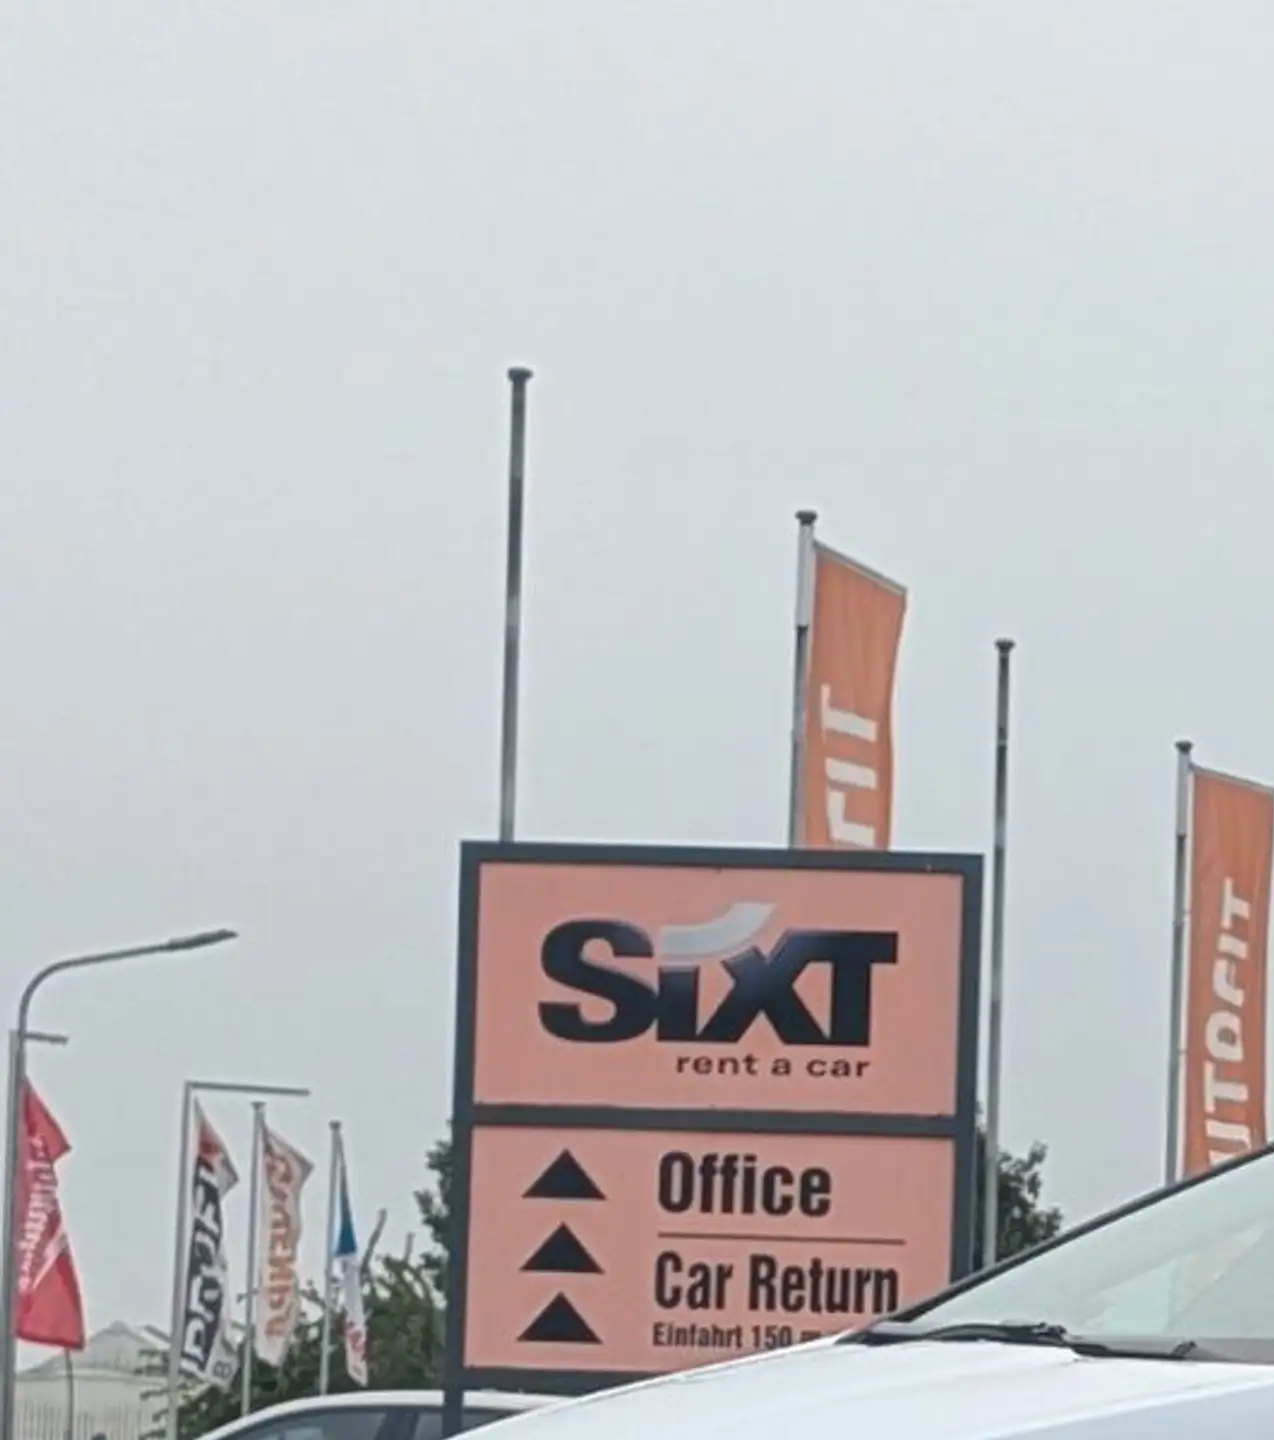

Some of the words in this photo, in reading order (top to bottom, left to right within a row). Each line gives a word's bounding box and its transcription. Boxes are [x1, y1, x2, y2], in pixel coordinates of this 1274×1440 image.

[675, 1053, 759, 1077] rent
[770, 1056, 793, 1078] a
[805, 1057, 872, 1079] car
[657, 1150, 833, 1218] Office
[653, 1250, 734, 1311] Car
[747, 1254, 899, 1315] Return
[652, 1321, 743, 1350] Einfahrt
[751, 1324, 794, 1349] 150
